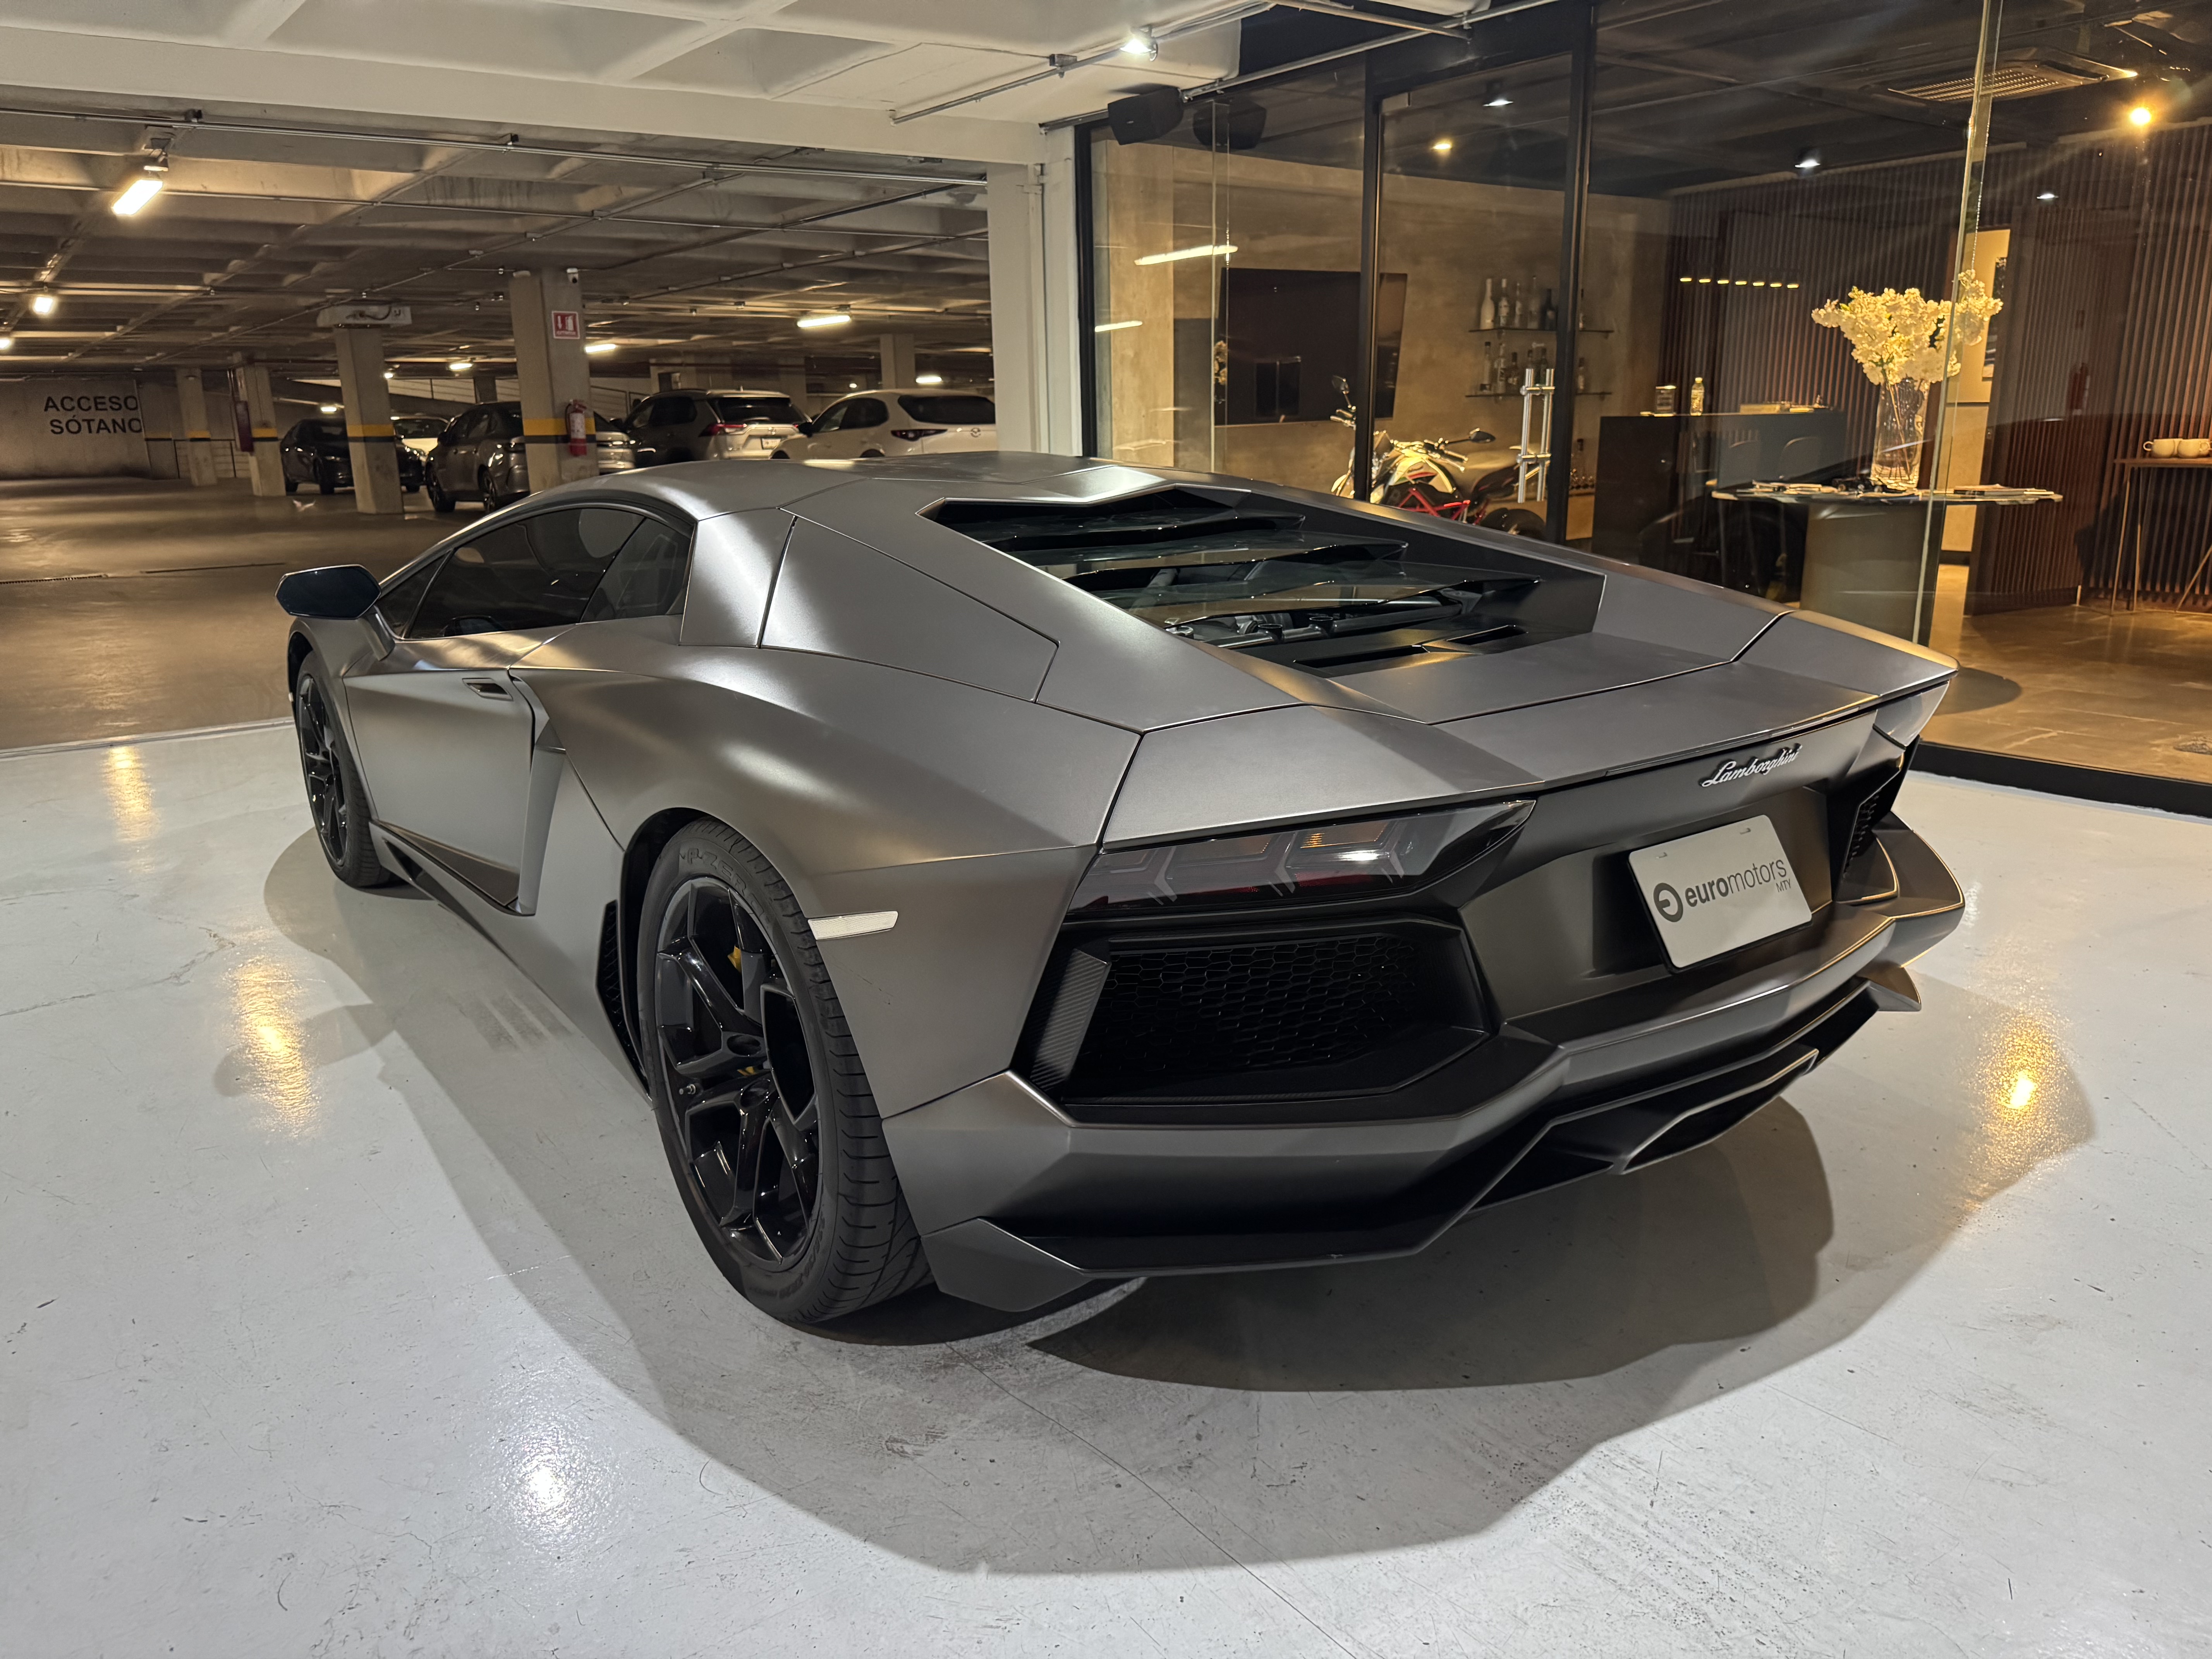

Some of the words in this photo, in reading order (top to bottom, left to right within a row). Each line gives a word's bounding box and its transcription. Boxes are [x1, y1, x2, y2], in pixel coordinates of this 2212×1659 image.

[44, 395, 138, 411] ACCESO
[50, 414, 143, 434] SÓTANO
[1702, 745, 1803, 787] Lamborghini
[1685, 859, 1787, 907] euromotors
[1776, 879, 1791, 892] MTY
